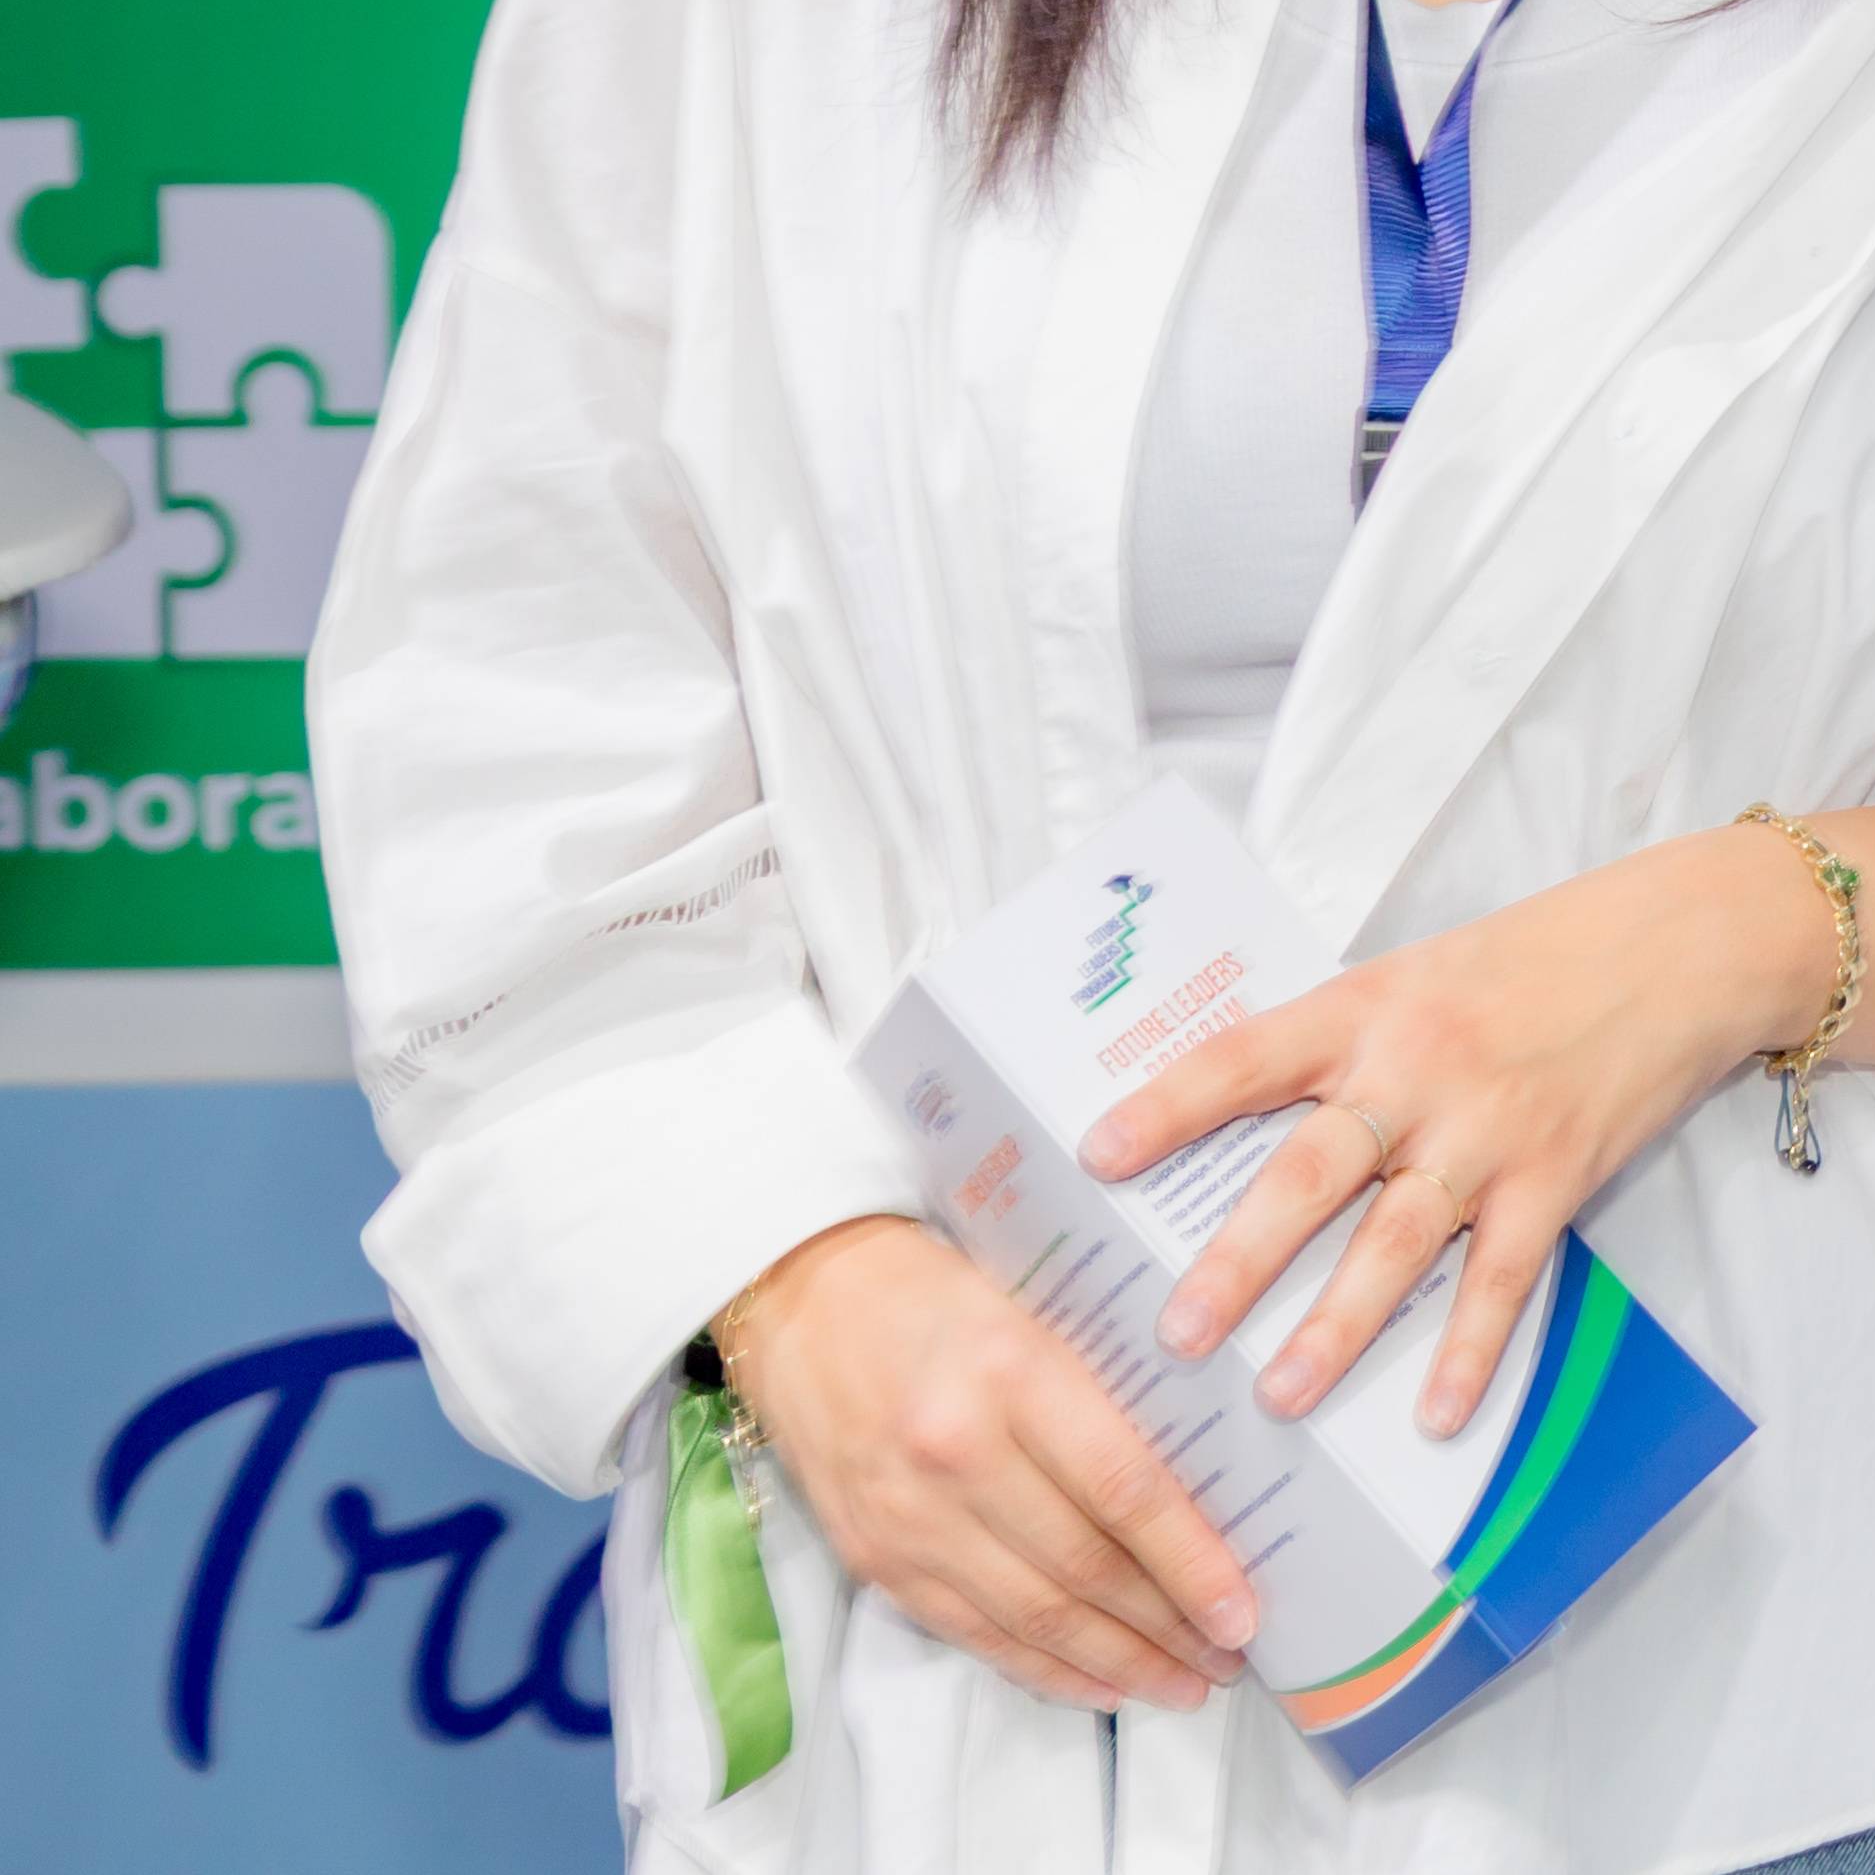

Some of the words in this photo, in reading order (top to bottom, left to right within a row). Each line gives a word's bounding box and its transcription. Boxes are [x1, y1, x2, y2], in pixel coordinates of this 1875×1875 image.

[1084, 915, 1123, 948] FUTURE
[1076, 941, 1122, 980] LEADERS
[1069, 966, 1119, 1008] PROGRAM
[1095, 1006, 1177, 1079] FUTURE
[1161, 950, 1245, 1025] LEADERS
[1236, 1119, 1259, 1142] and
[1140, 1163, 1176, 1196] equips
